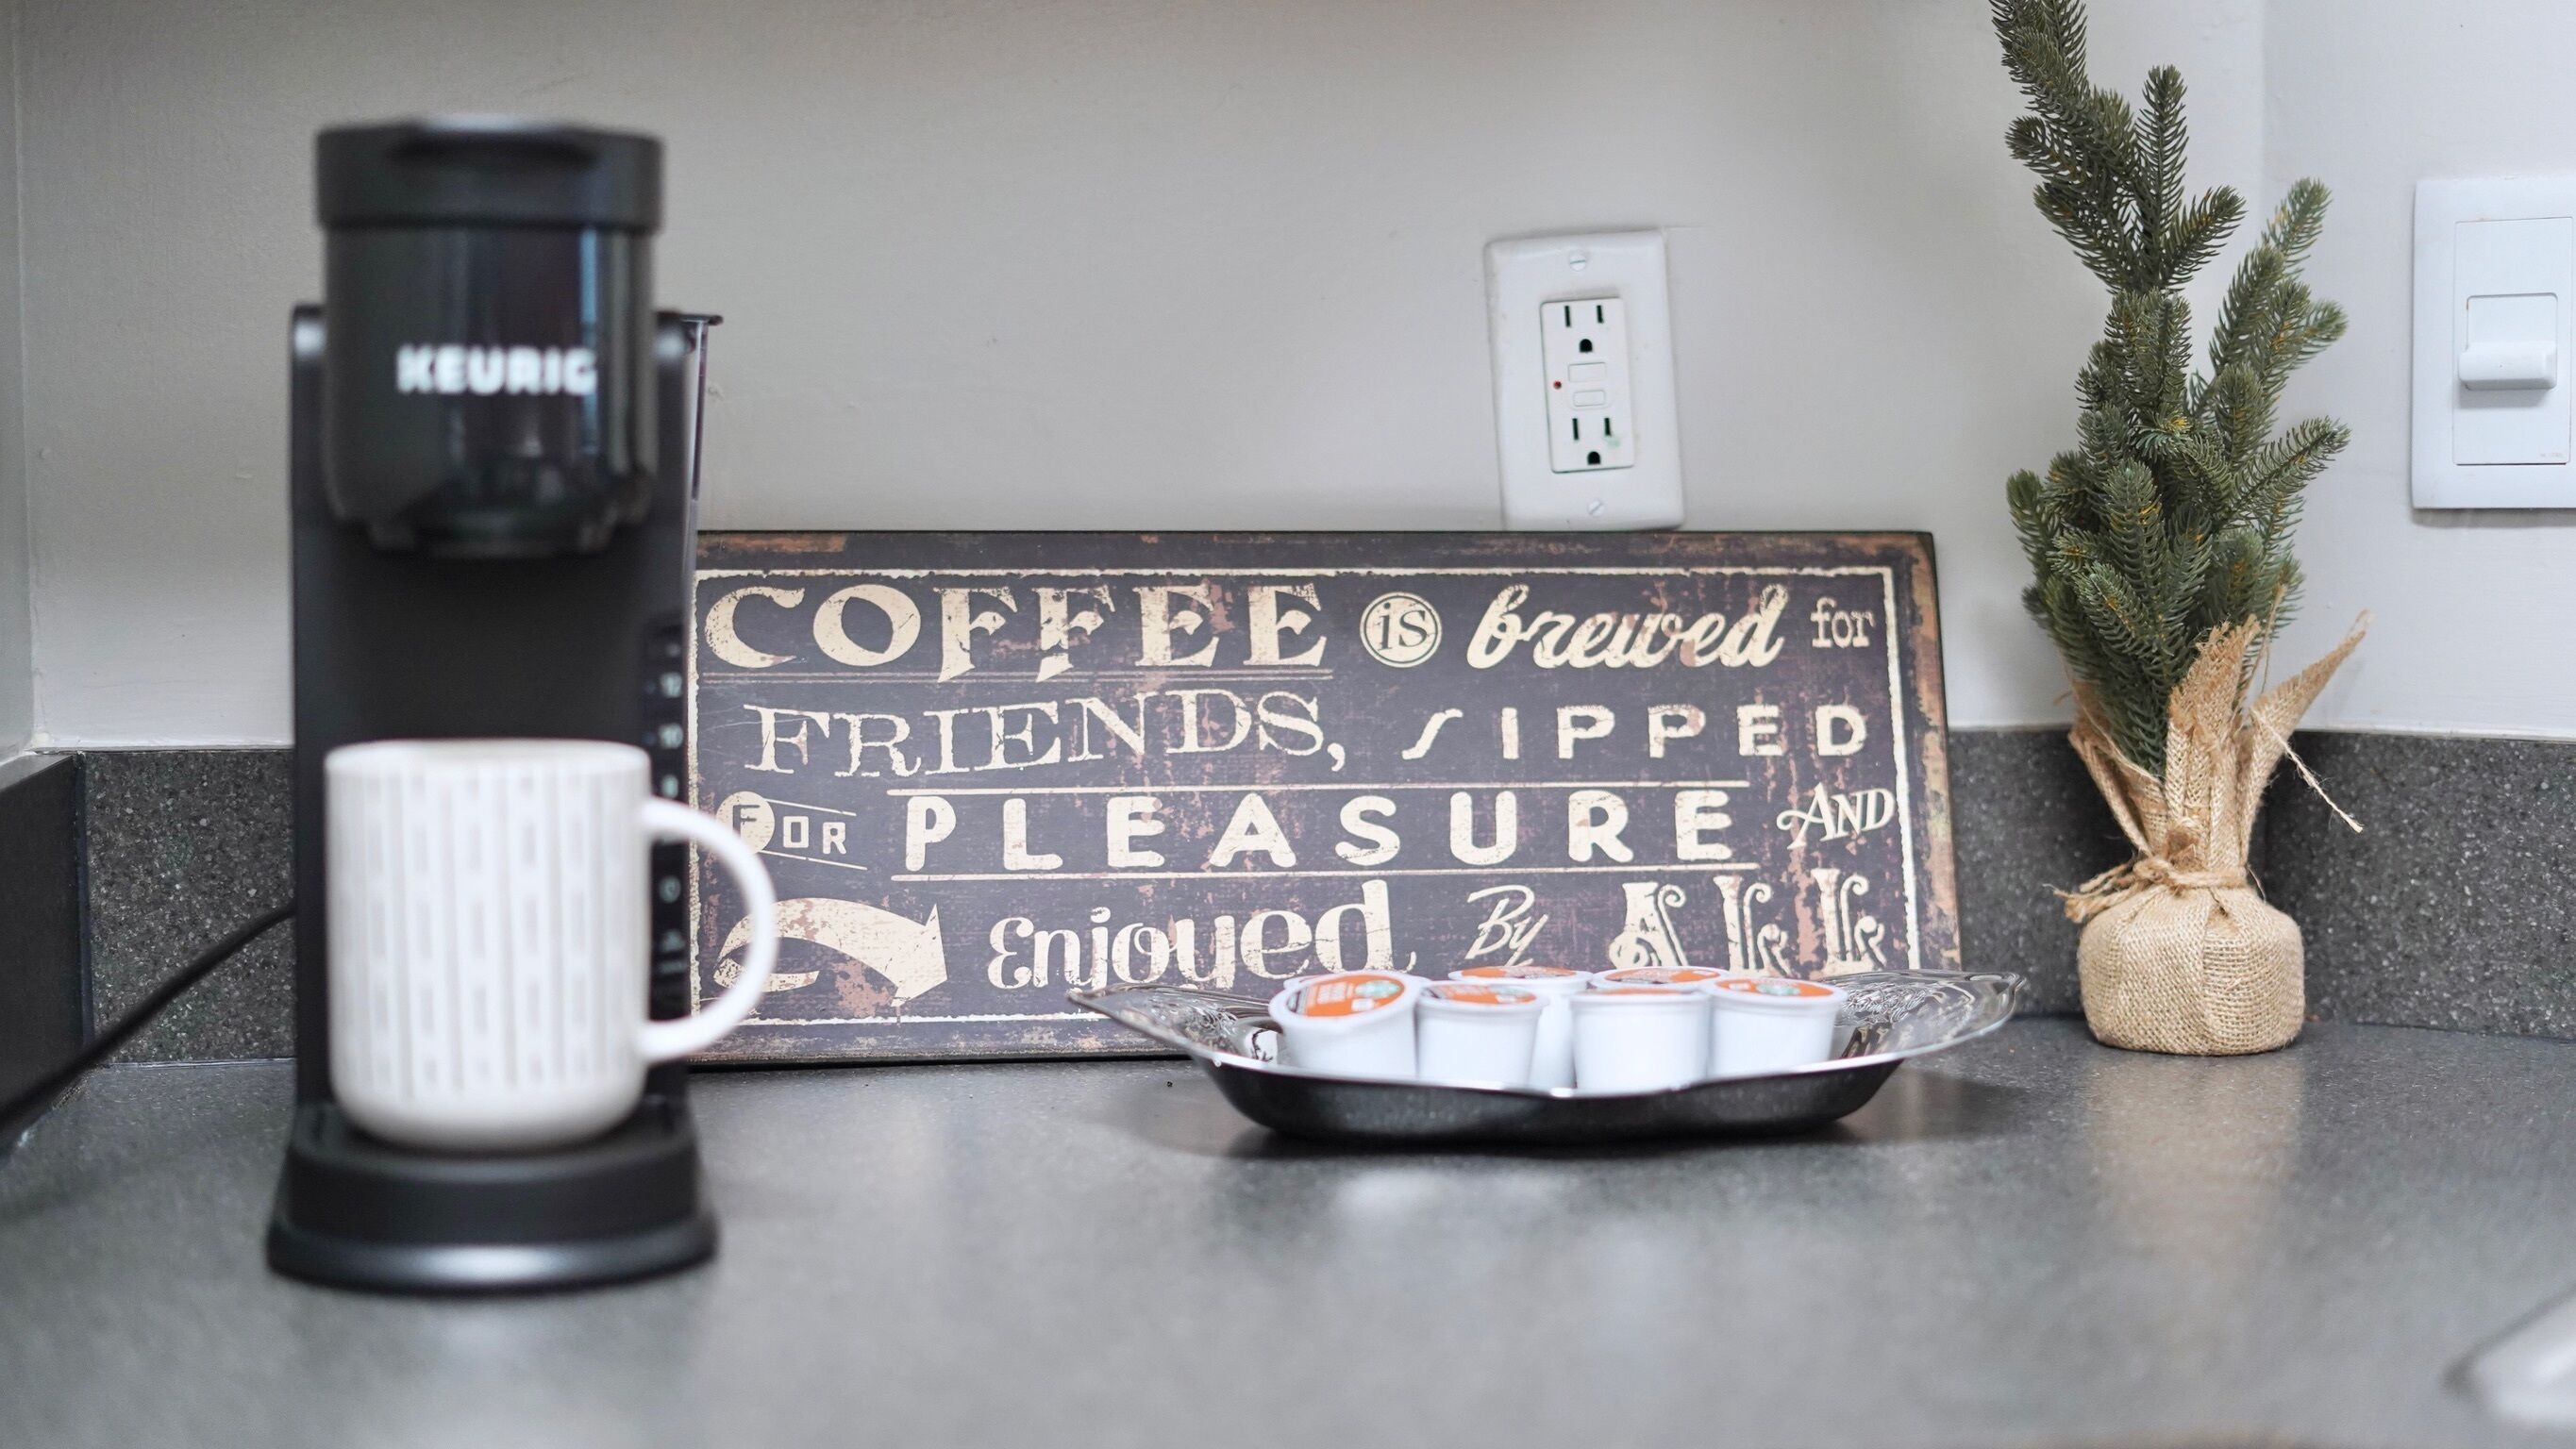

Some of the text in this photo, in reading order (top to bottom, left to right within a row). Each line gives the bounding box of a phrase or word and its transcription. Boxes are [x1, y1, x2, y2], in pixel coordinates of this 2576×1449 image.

[396, 345, 598, 395] KEURIG
[704, 582, 1875, 683] COFFEE is brewed for
[744, 689, 1867, 778] FRIENDS, SIPPED
[731, 782, 1897, 873] FOR PLEASURE AND
[986, 867, 1887, 991] Enjoyed By ALL
